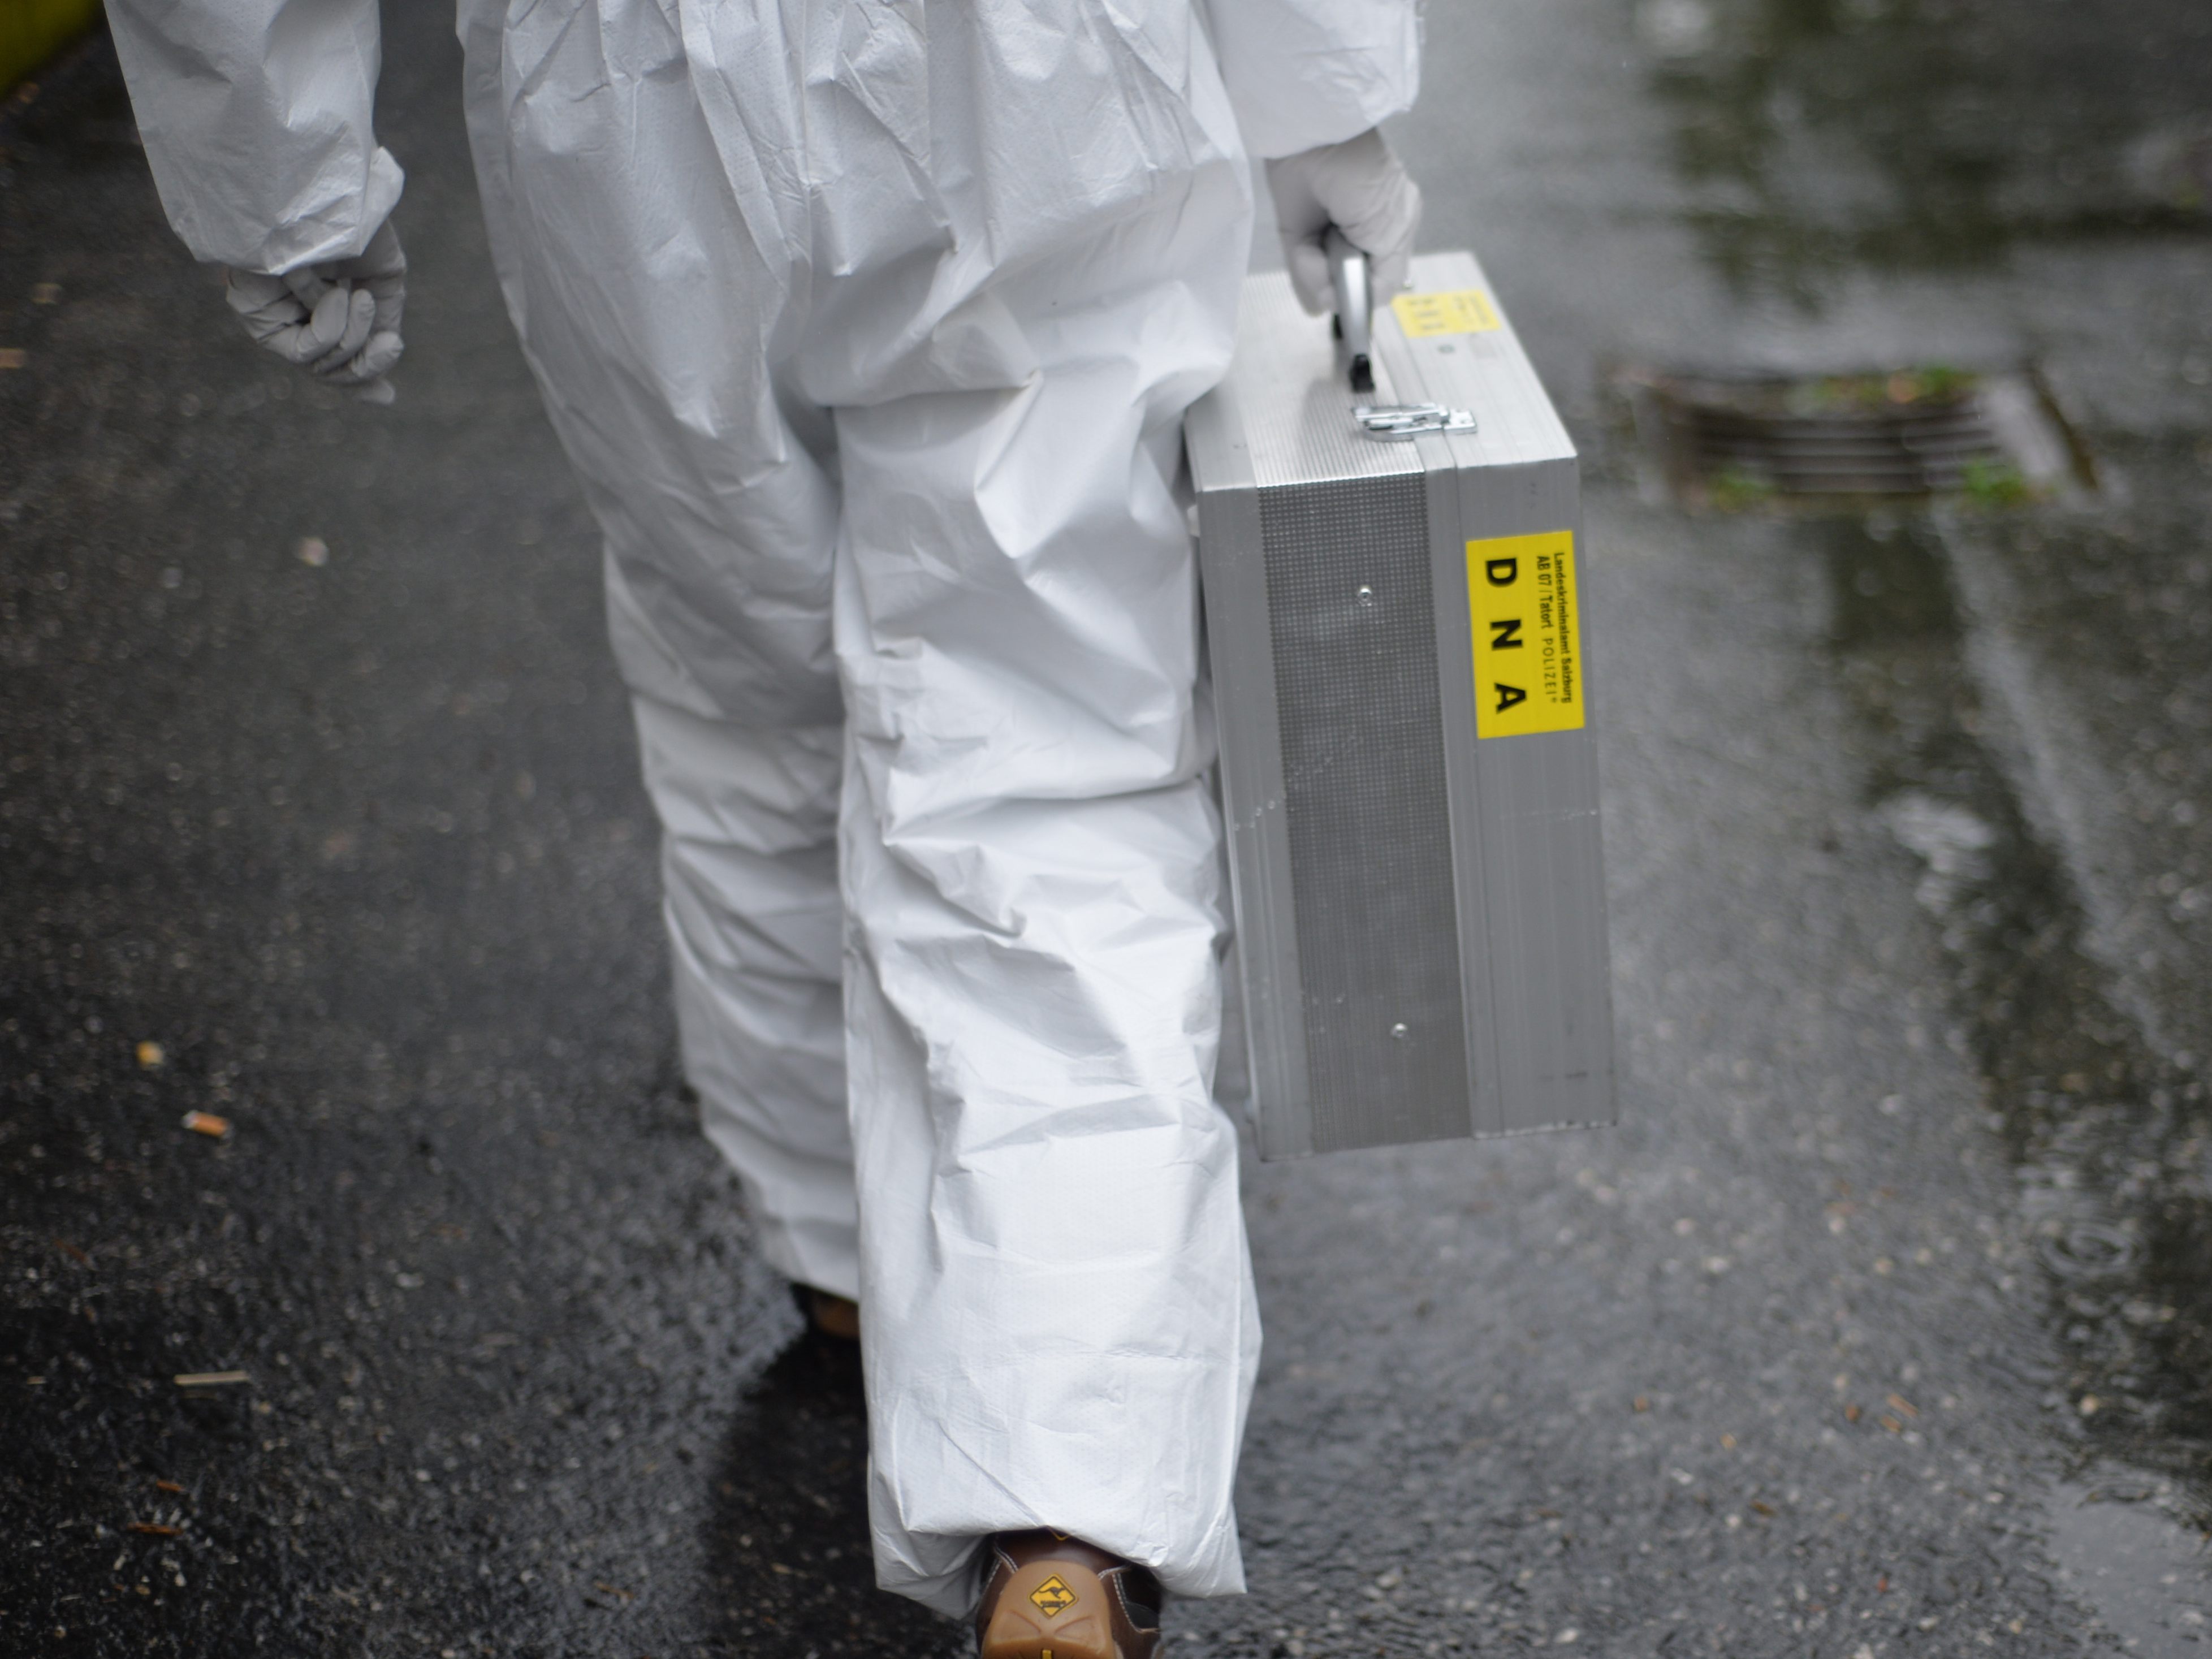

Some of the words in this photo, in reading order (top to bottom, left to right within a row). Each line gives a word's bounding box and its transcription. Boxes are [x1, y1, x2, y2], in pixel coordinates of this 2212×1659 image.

[1537, 556, 1550, 571] AB
[1537, 574, 1552, 586] 07
[1539, 596, 1554, 629] Tatort
[1554, 552, 1570, 655] Landeskriminalamt
[1561, 658, 1574, 703] Salzburg
